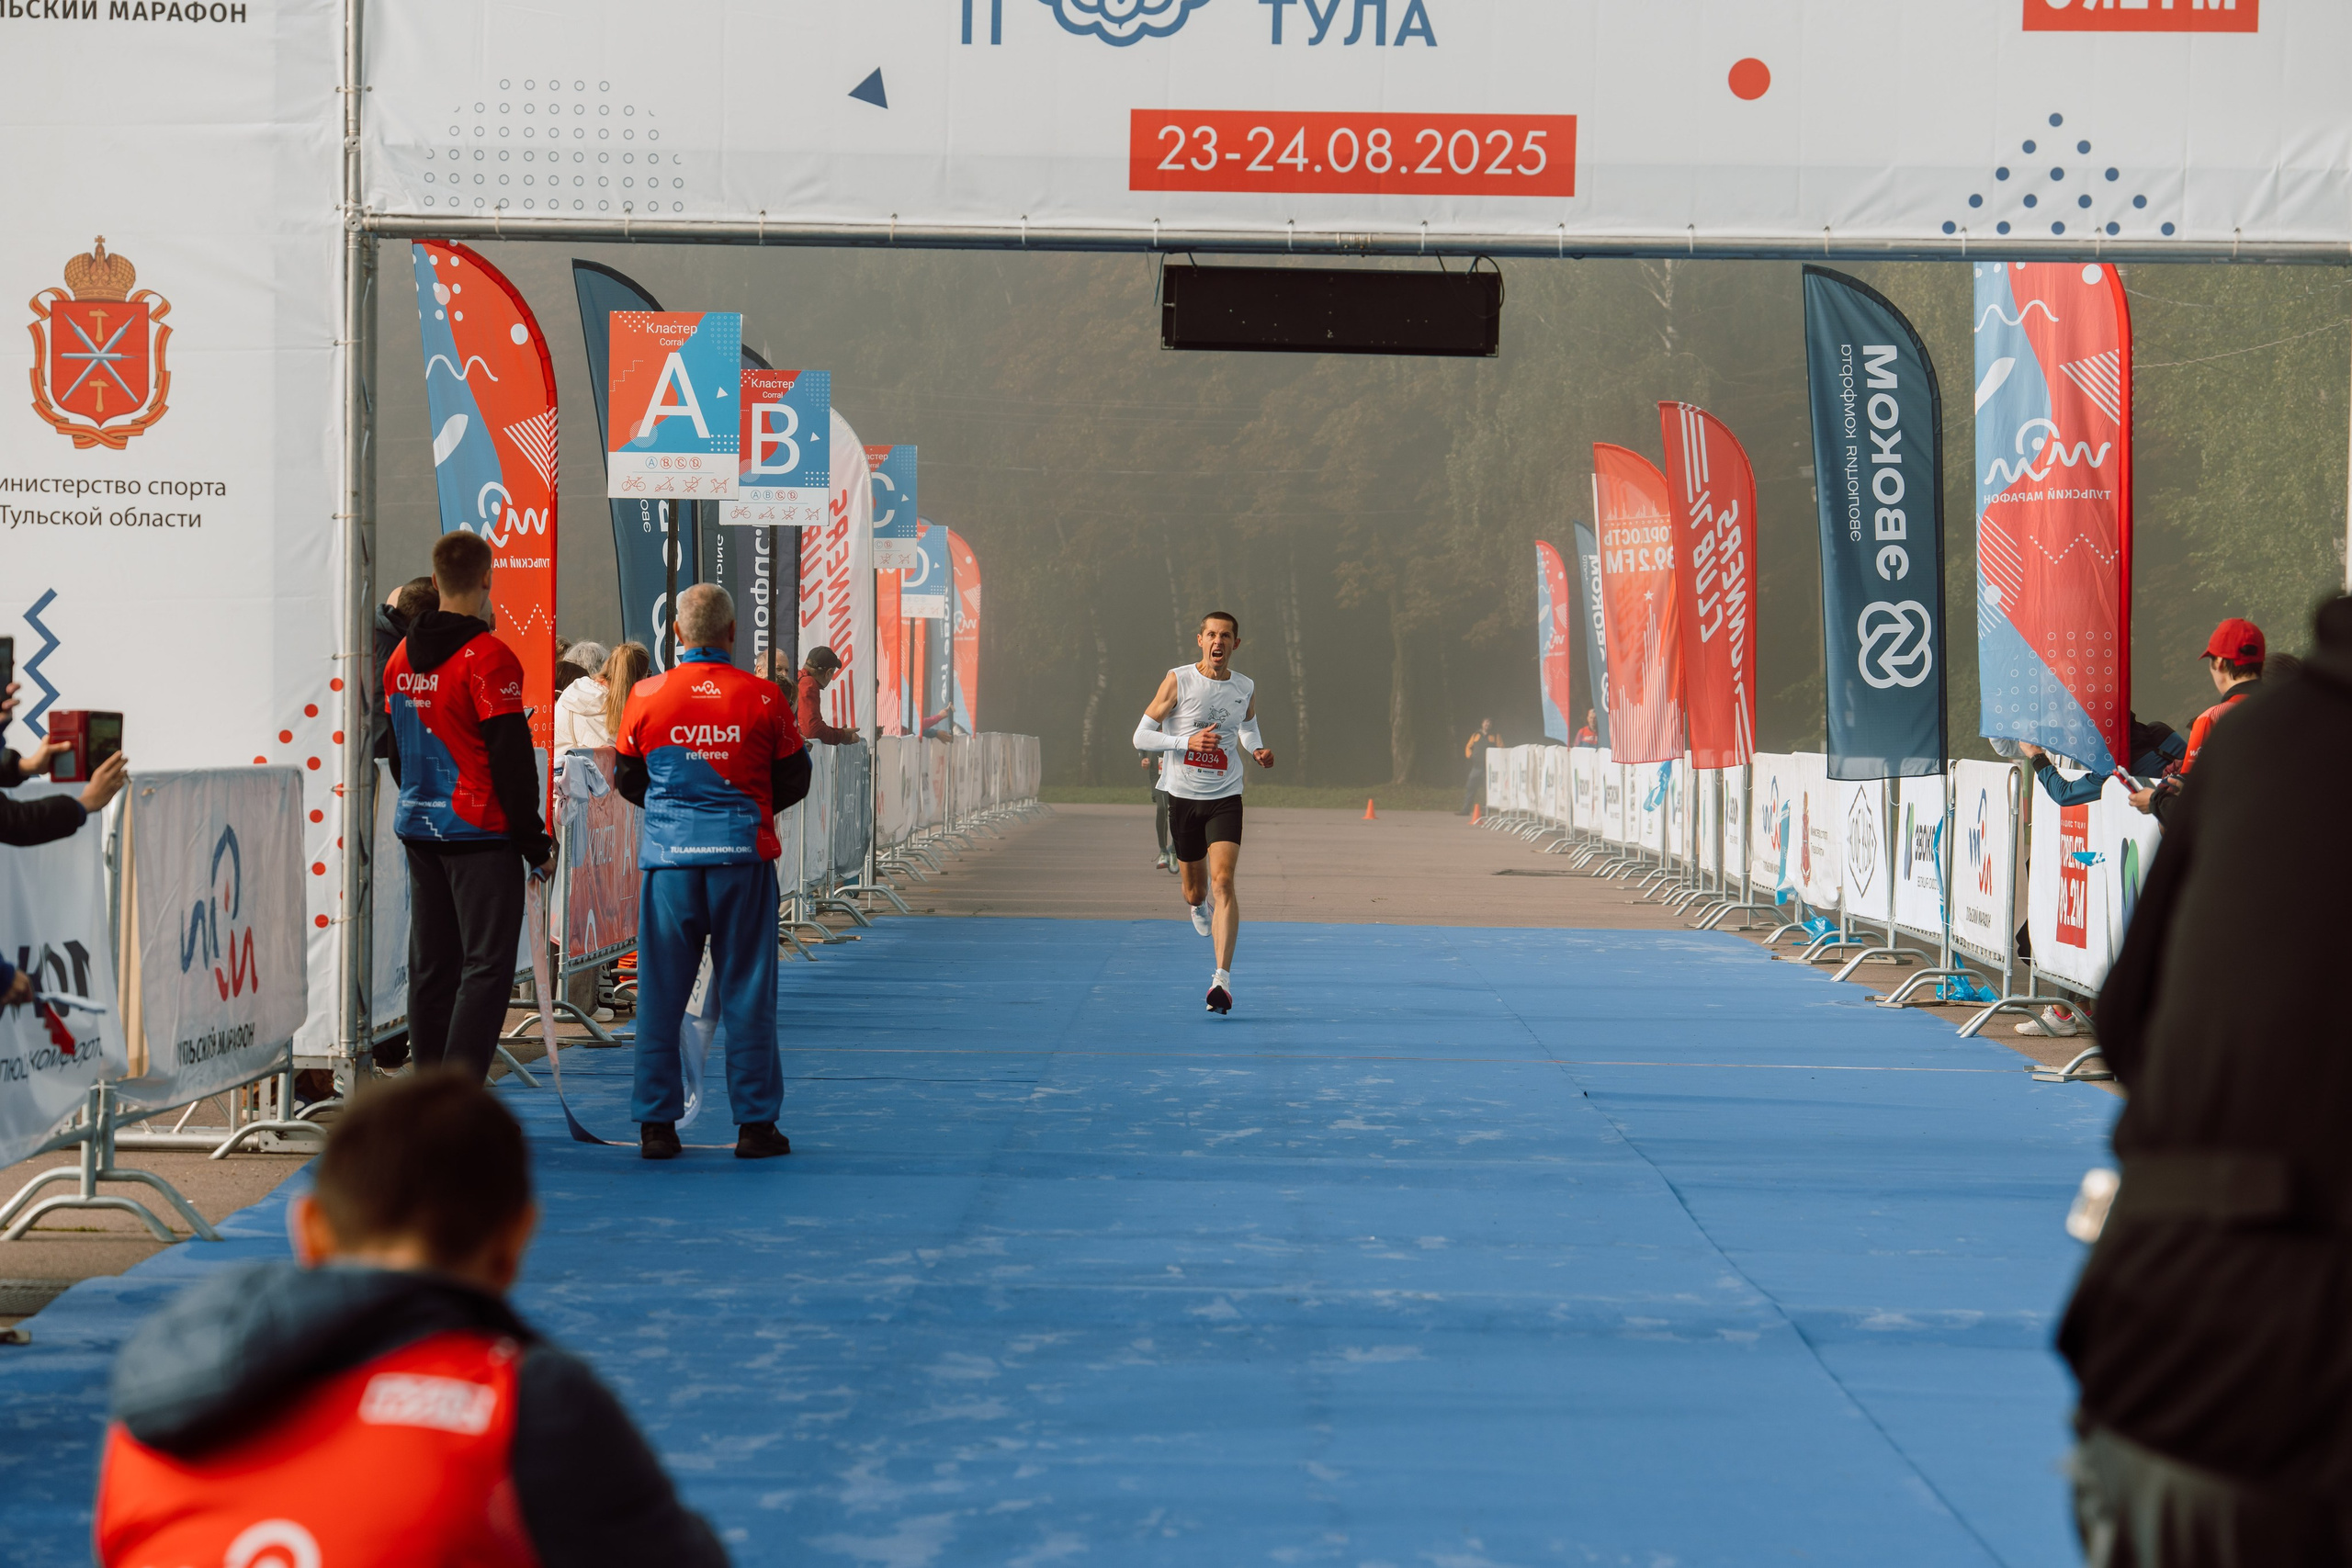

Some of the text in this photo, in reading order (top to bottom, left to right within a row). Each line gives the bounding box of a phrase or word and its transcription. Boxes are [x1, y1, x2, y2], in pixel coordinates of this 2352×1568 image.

[108, 2, 246, 23] МАРАФОН
[1258, 0, 1438, 47] ТУЛА
[1157, 125, 1547, 176] 23-24.08.2025
[646, 321, 698, 336] Кластер
[659, 337, 684, 347] Corral
[751, 378, 795, 391] Кластер
[762, 390, 784, 399] Corral
[636, 352, 711, 439] A
[751, 402, 801, 475] B
[865, 453, 888, 462] астер
[148, 480, 226, 501] спорта
[0, 504, 201, 529] Тульской области
[396, 673, 439, 694] СУДЬЯ
[670, 725, 741, 746] СУДЬЯ
[685, 749, 729, 761] referee
[1195, 752, 1219, 763] 2034
[670, 845, 752, 854] TULAMARATHON.ORG
[1914, 824, 1939, 863] ЭВОКО
